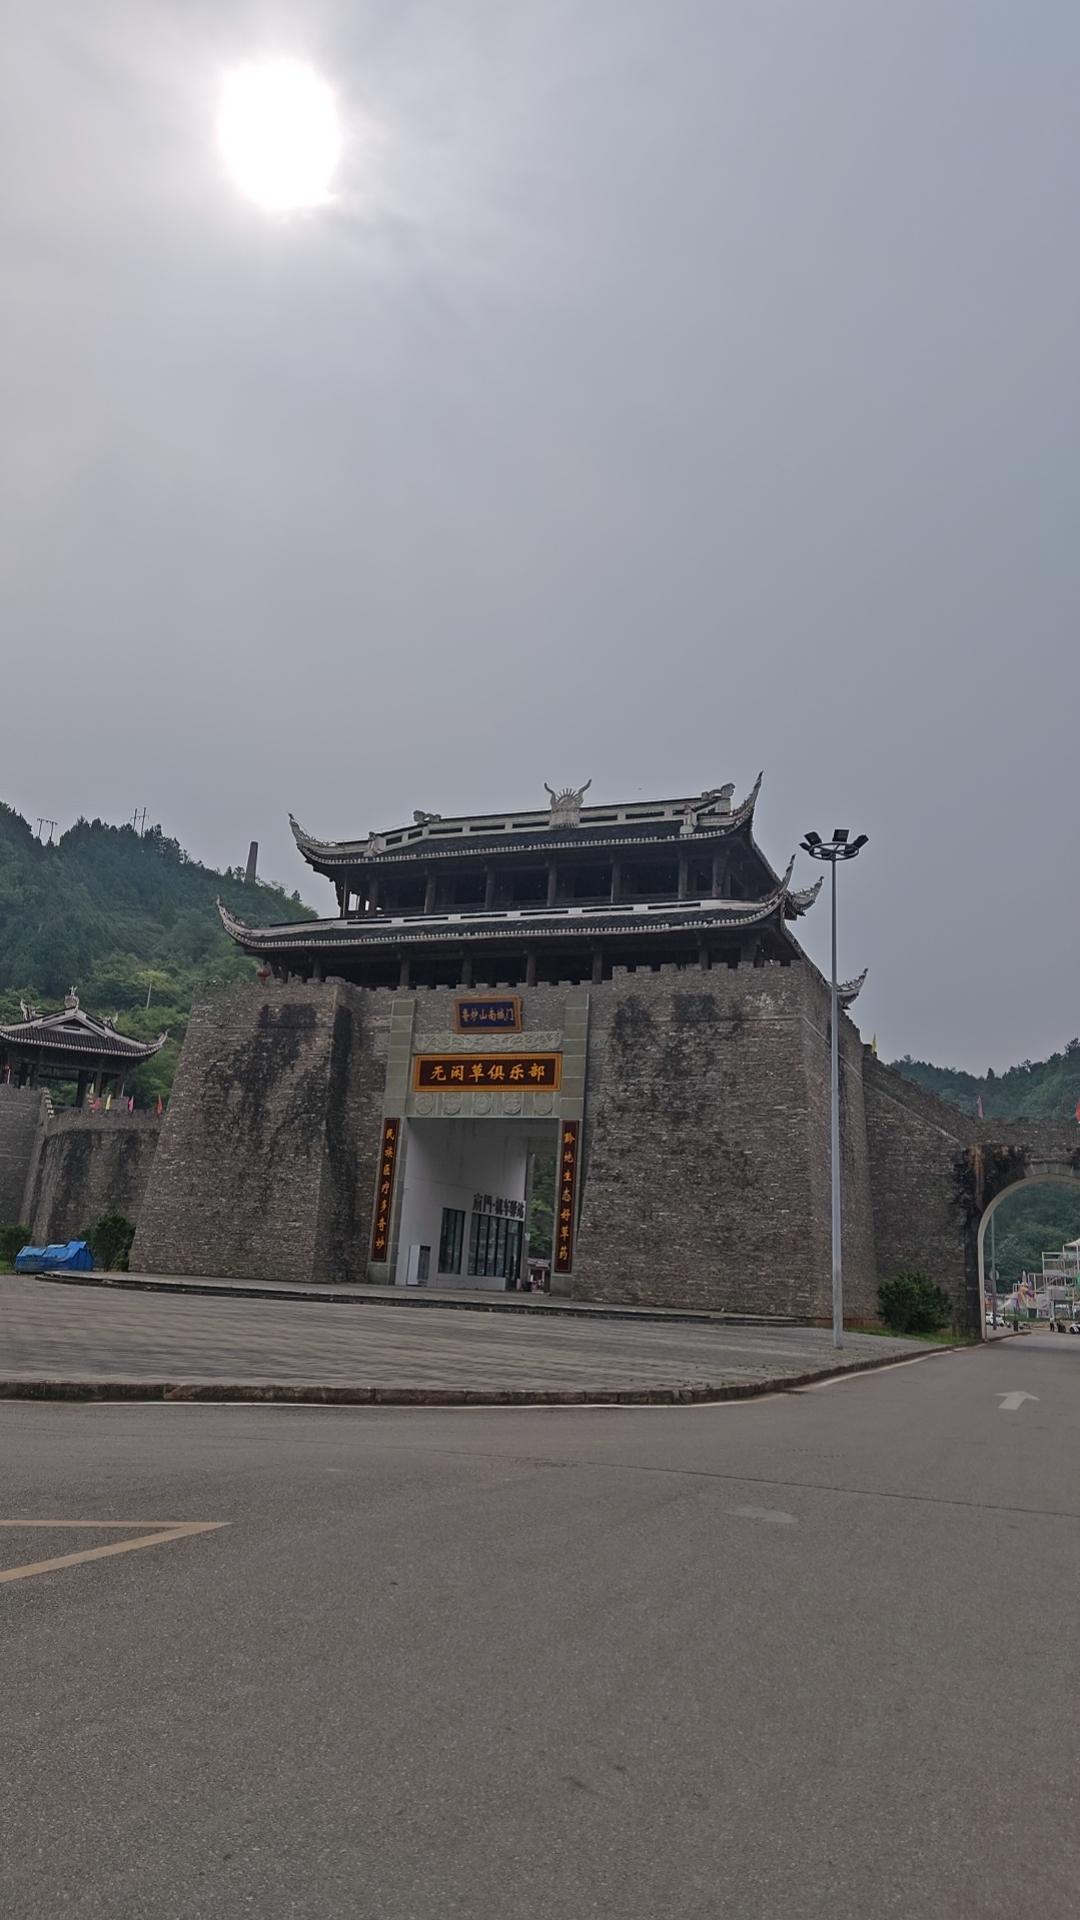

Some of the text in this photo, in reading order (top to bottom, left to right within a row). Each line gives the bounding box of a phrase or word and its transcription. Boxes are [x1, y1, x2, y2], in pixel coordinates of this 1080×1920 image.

[429, 1062, 545, 1082] 无闲草俱乐部
